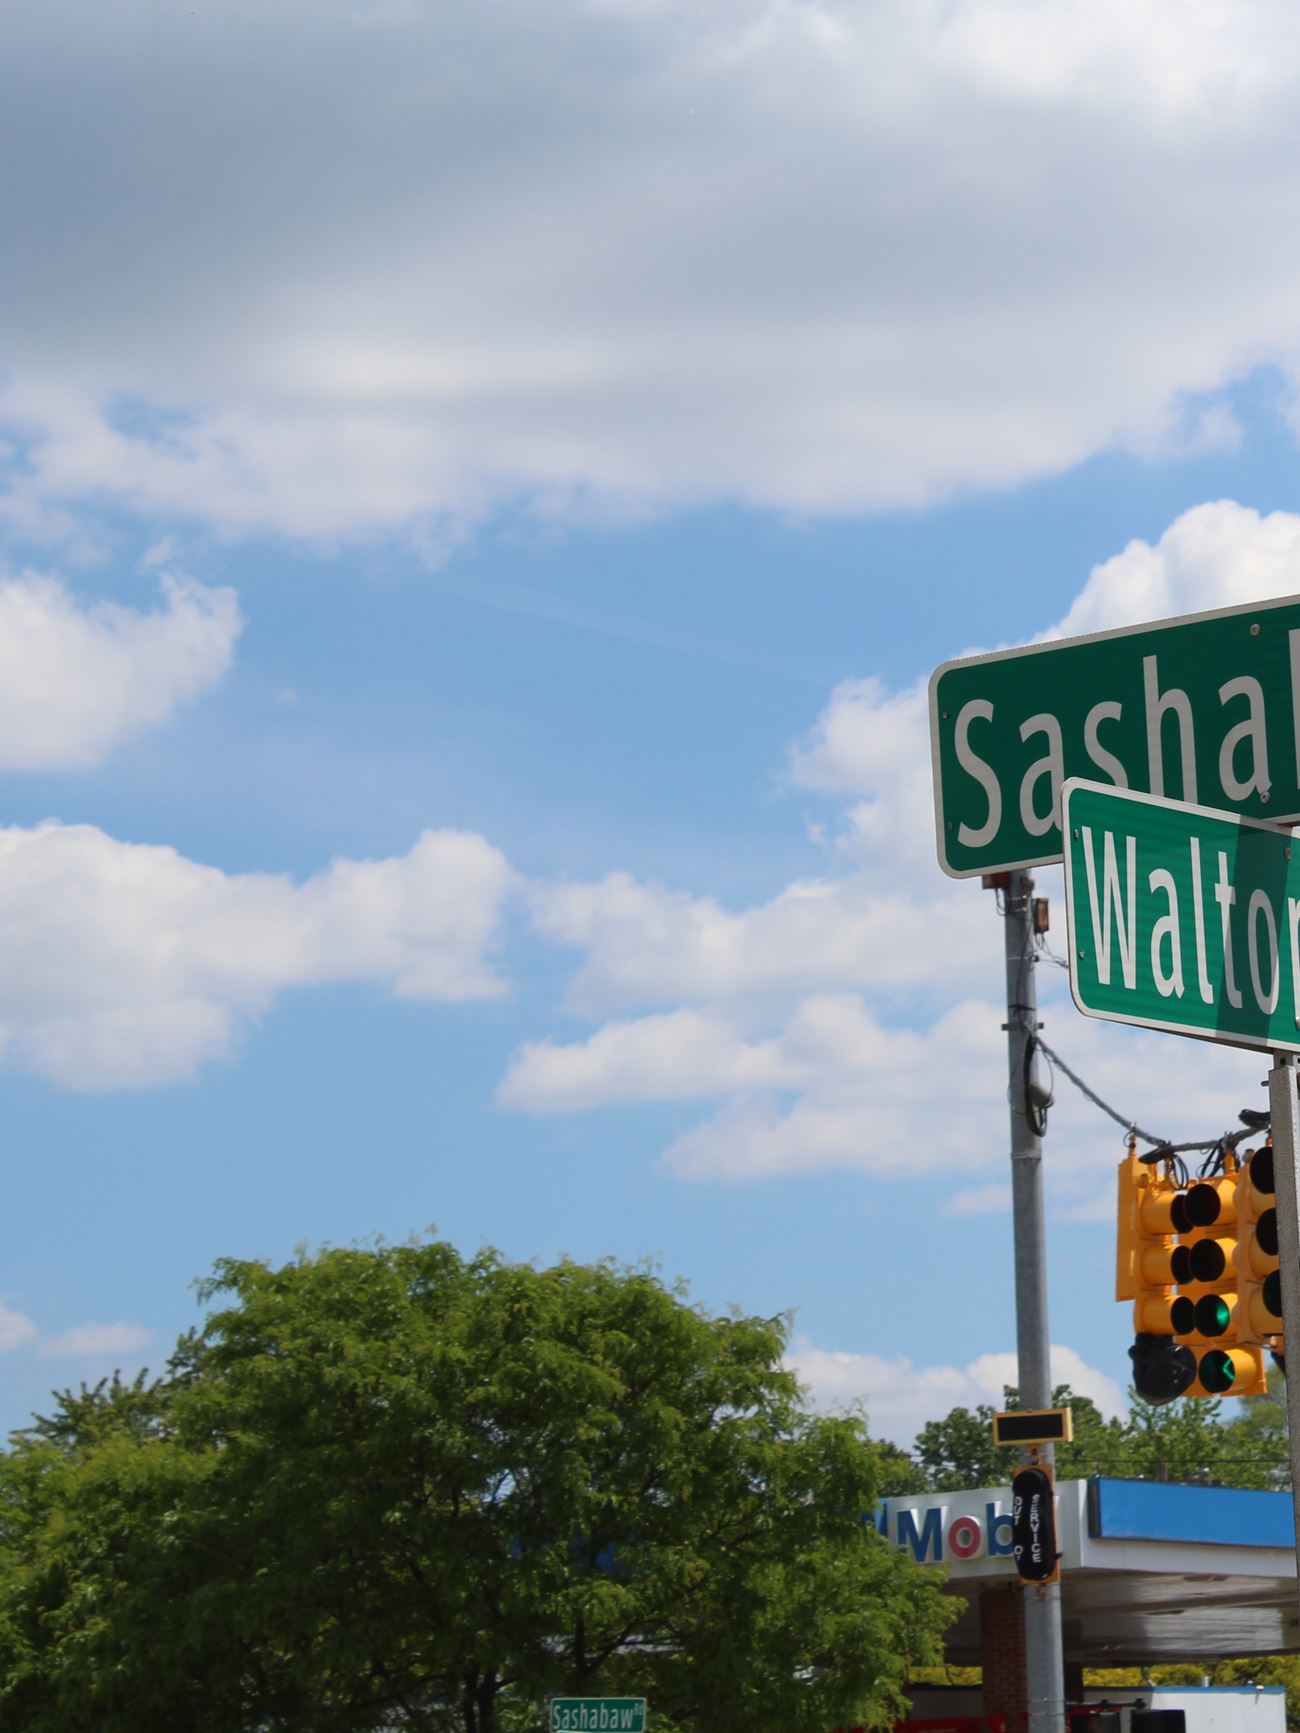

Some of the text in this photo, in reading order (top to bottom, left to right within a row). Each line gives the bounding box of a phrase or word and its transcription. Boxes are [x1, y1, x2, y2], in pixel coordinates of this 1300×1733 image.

[897, 1501, 1014, 1563] Mob
[1013, 1496, 1023, 1526] OUT
[1030, 1494, 1042, 1563] SERVICE
[552, 1703, 633, 1729] Sashabaw
